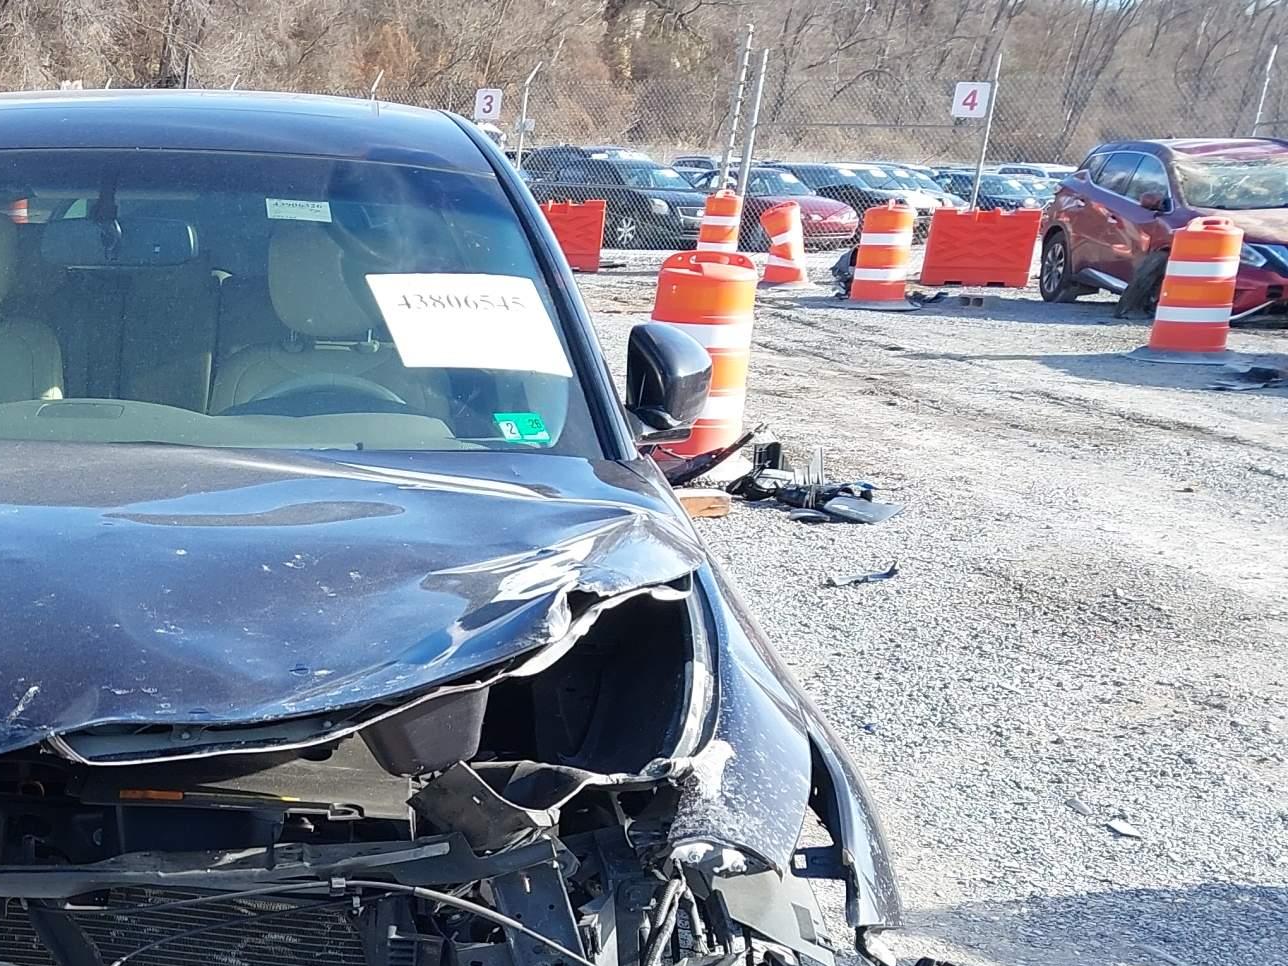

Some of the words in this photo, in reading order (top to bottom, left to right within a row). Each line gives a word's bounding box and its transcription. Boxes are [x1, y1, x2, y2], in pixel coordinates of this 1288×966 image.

[482, 94, 494, 114] 3
[962, 89, 978, 111] 4
[506, 422, 516, 435] 2
